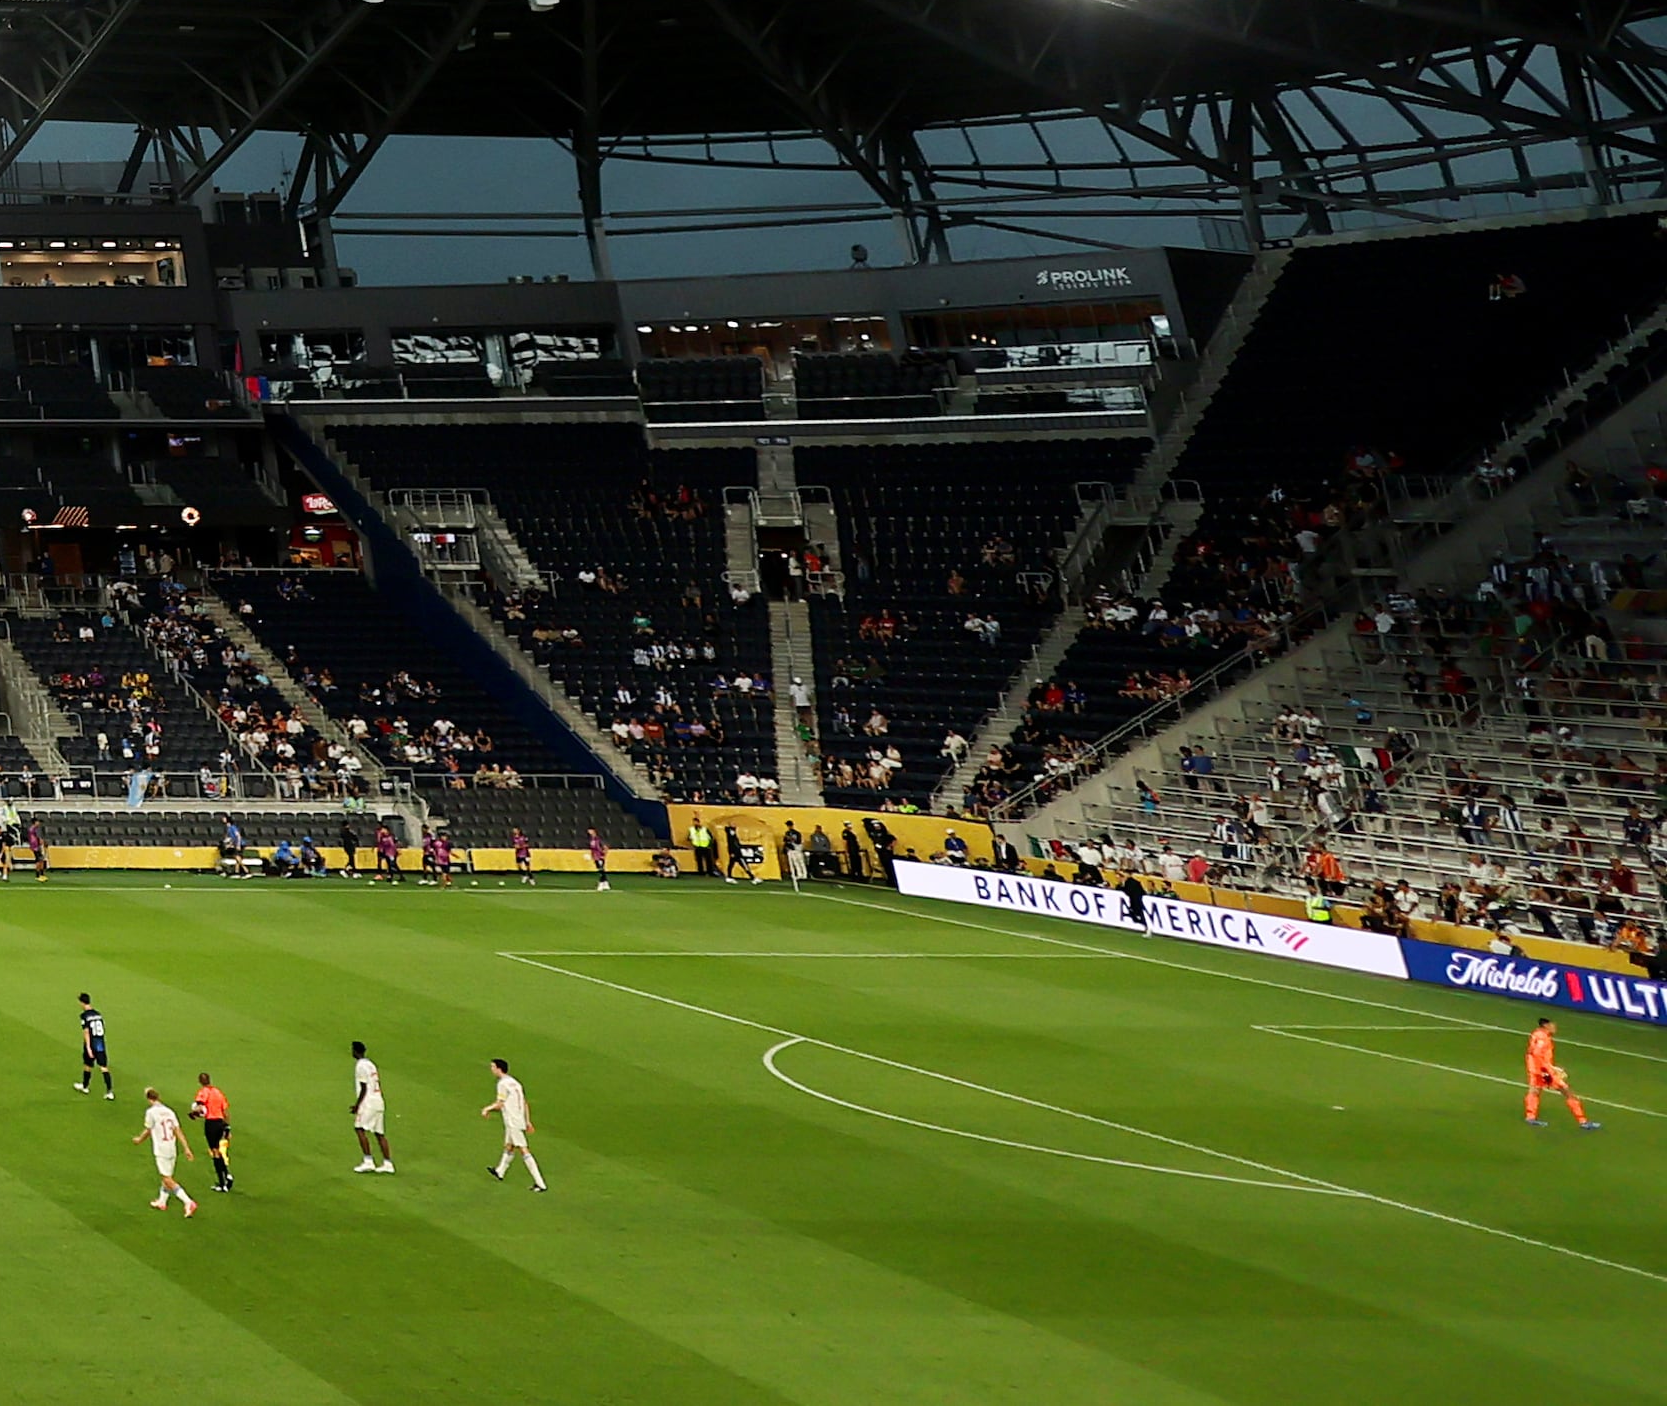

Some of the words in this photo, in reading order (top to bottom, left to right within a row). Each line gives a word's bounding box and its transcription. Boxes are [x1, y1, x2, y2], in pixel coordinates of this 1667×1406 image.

[1051, 268, 1129, 283] PROLINK
[973, 875, 1061, 913] BANK
[1070, 890, 1107, 919] OF
[1120, 897, 1264, 947] AMERICA
[1446, 951, 1559, 999] Michelob
[1587, 975, 1667, 1018] ULT
